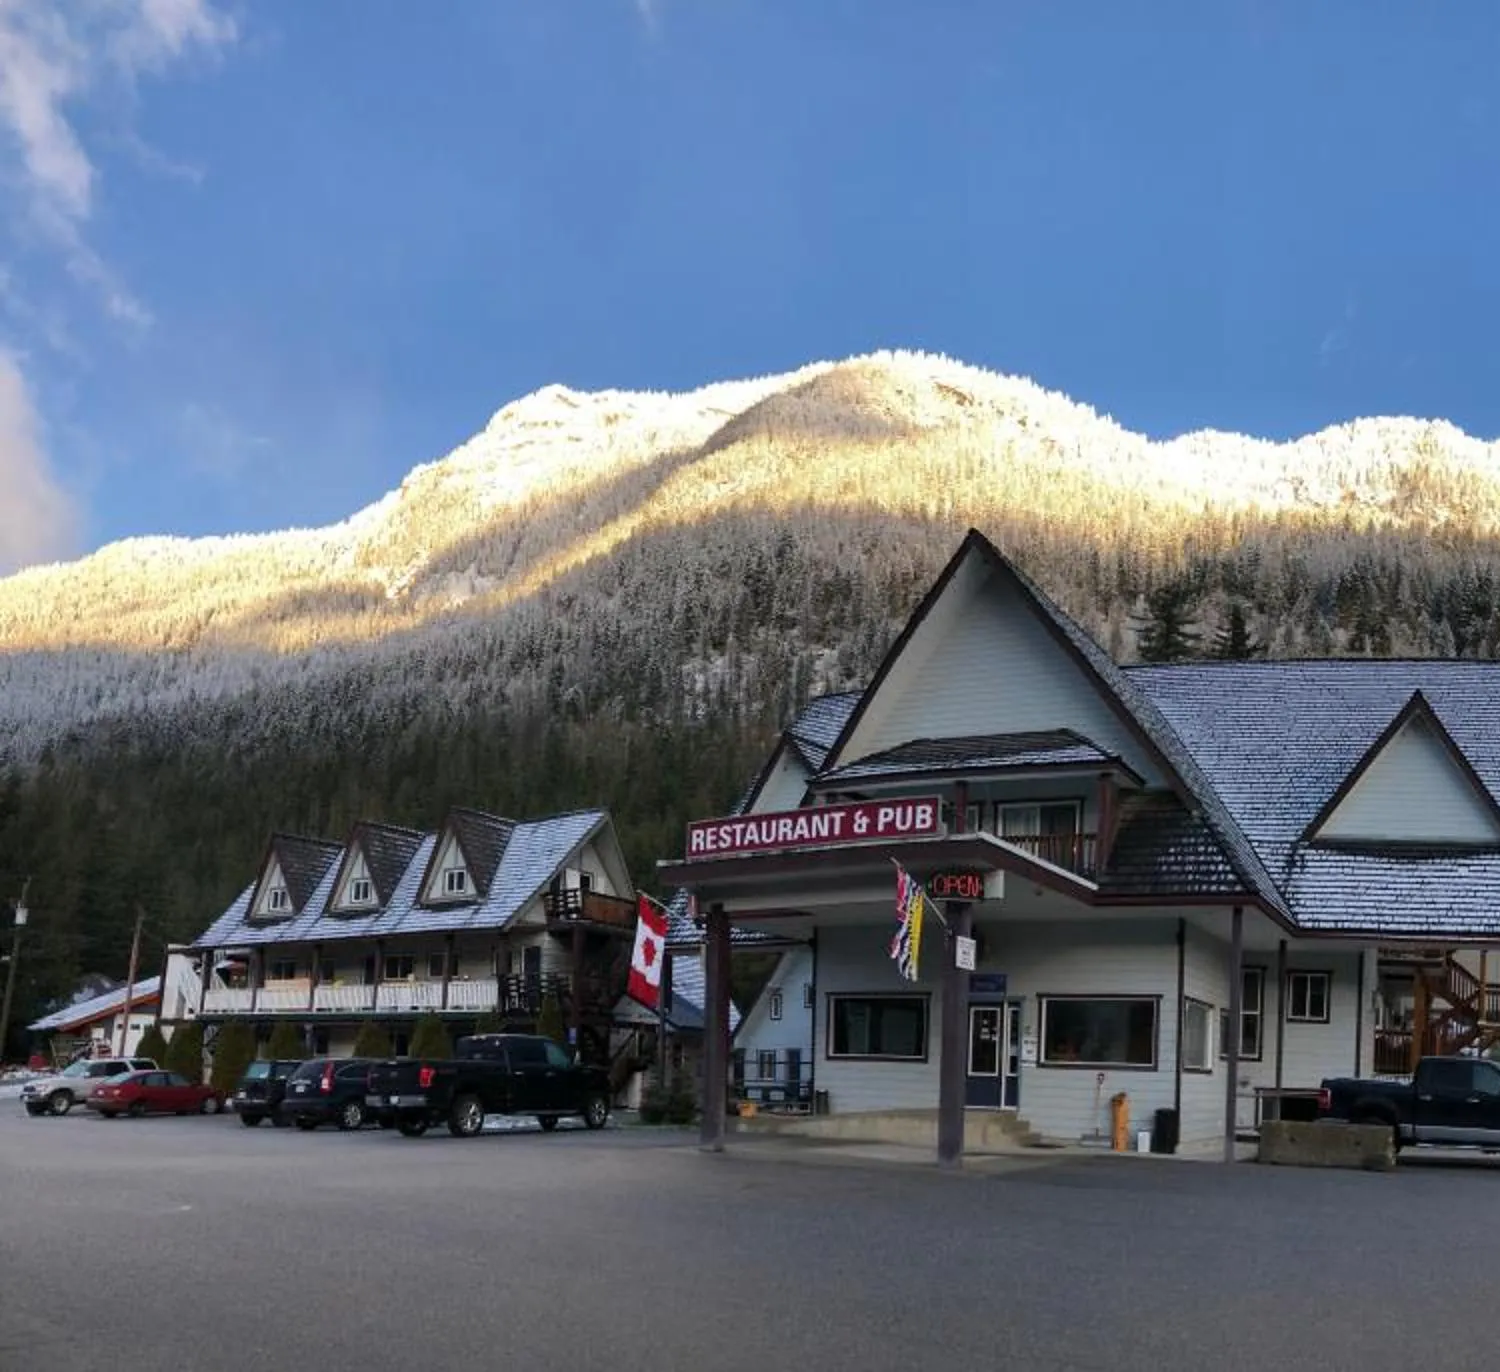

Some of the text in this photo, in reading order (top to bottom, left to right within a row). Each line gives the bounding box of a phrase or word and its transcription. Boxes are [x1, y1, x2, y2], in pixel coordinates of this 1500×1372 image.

[691, 804, 933, 852] RESTAURANT & PUB
[933, 874, 980, 897] OPEN
